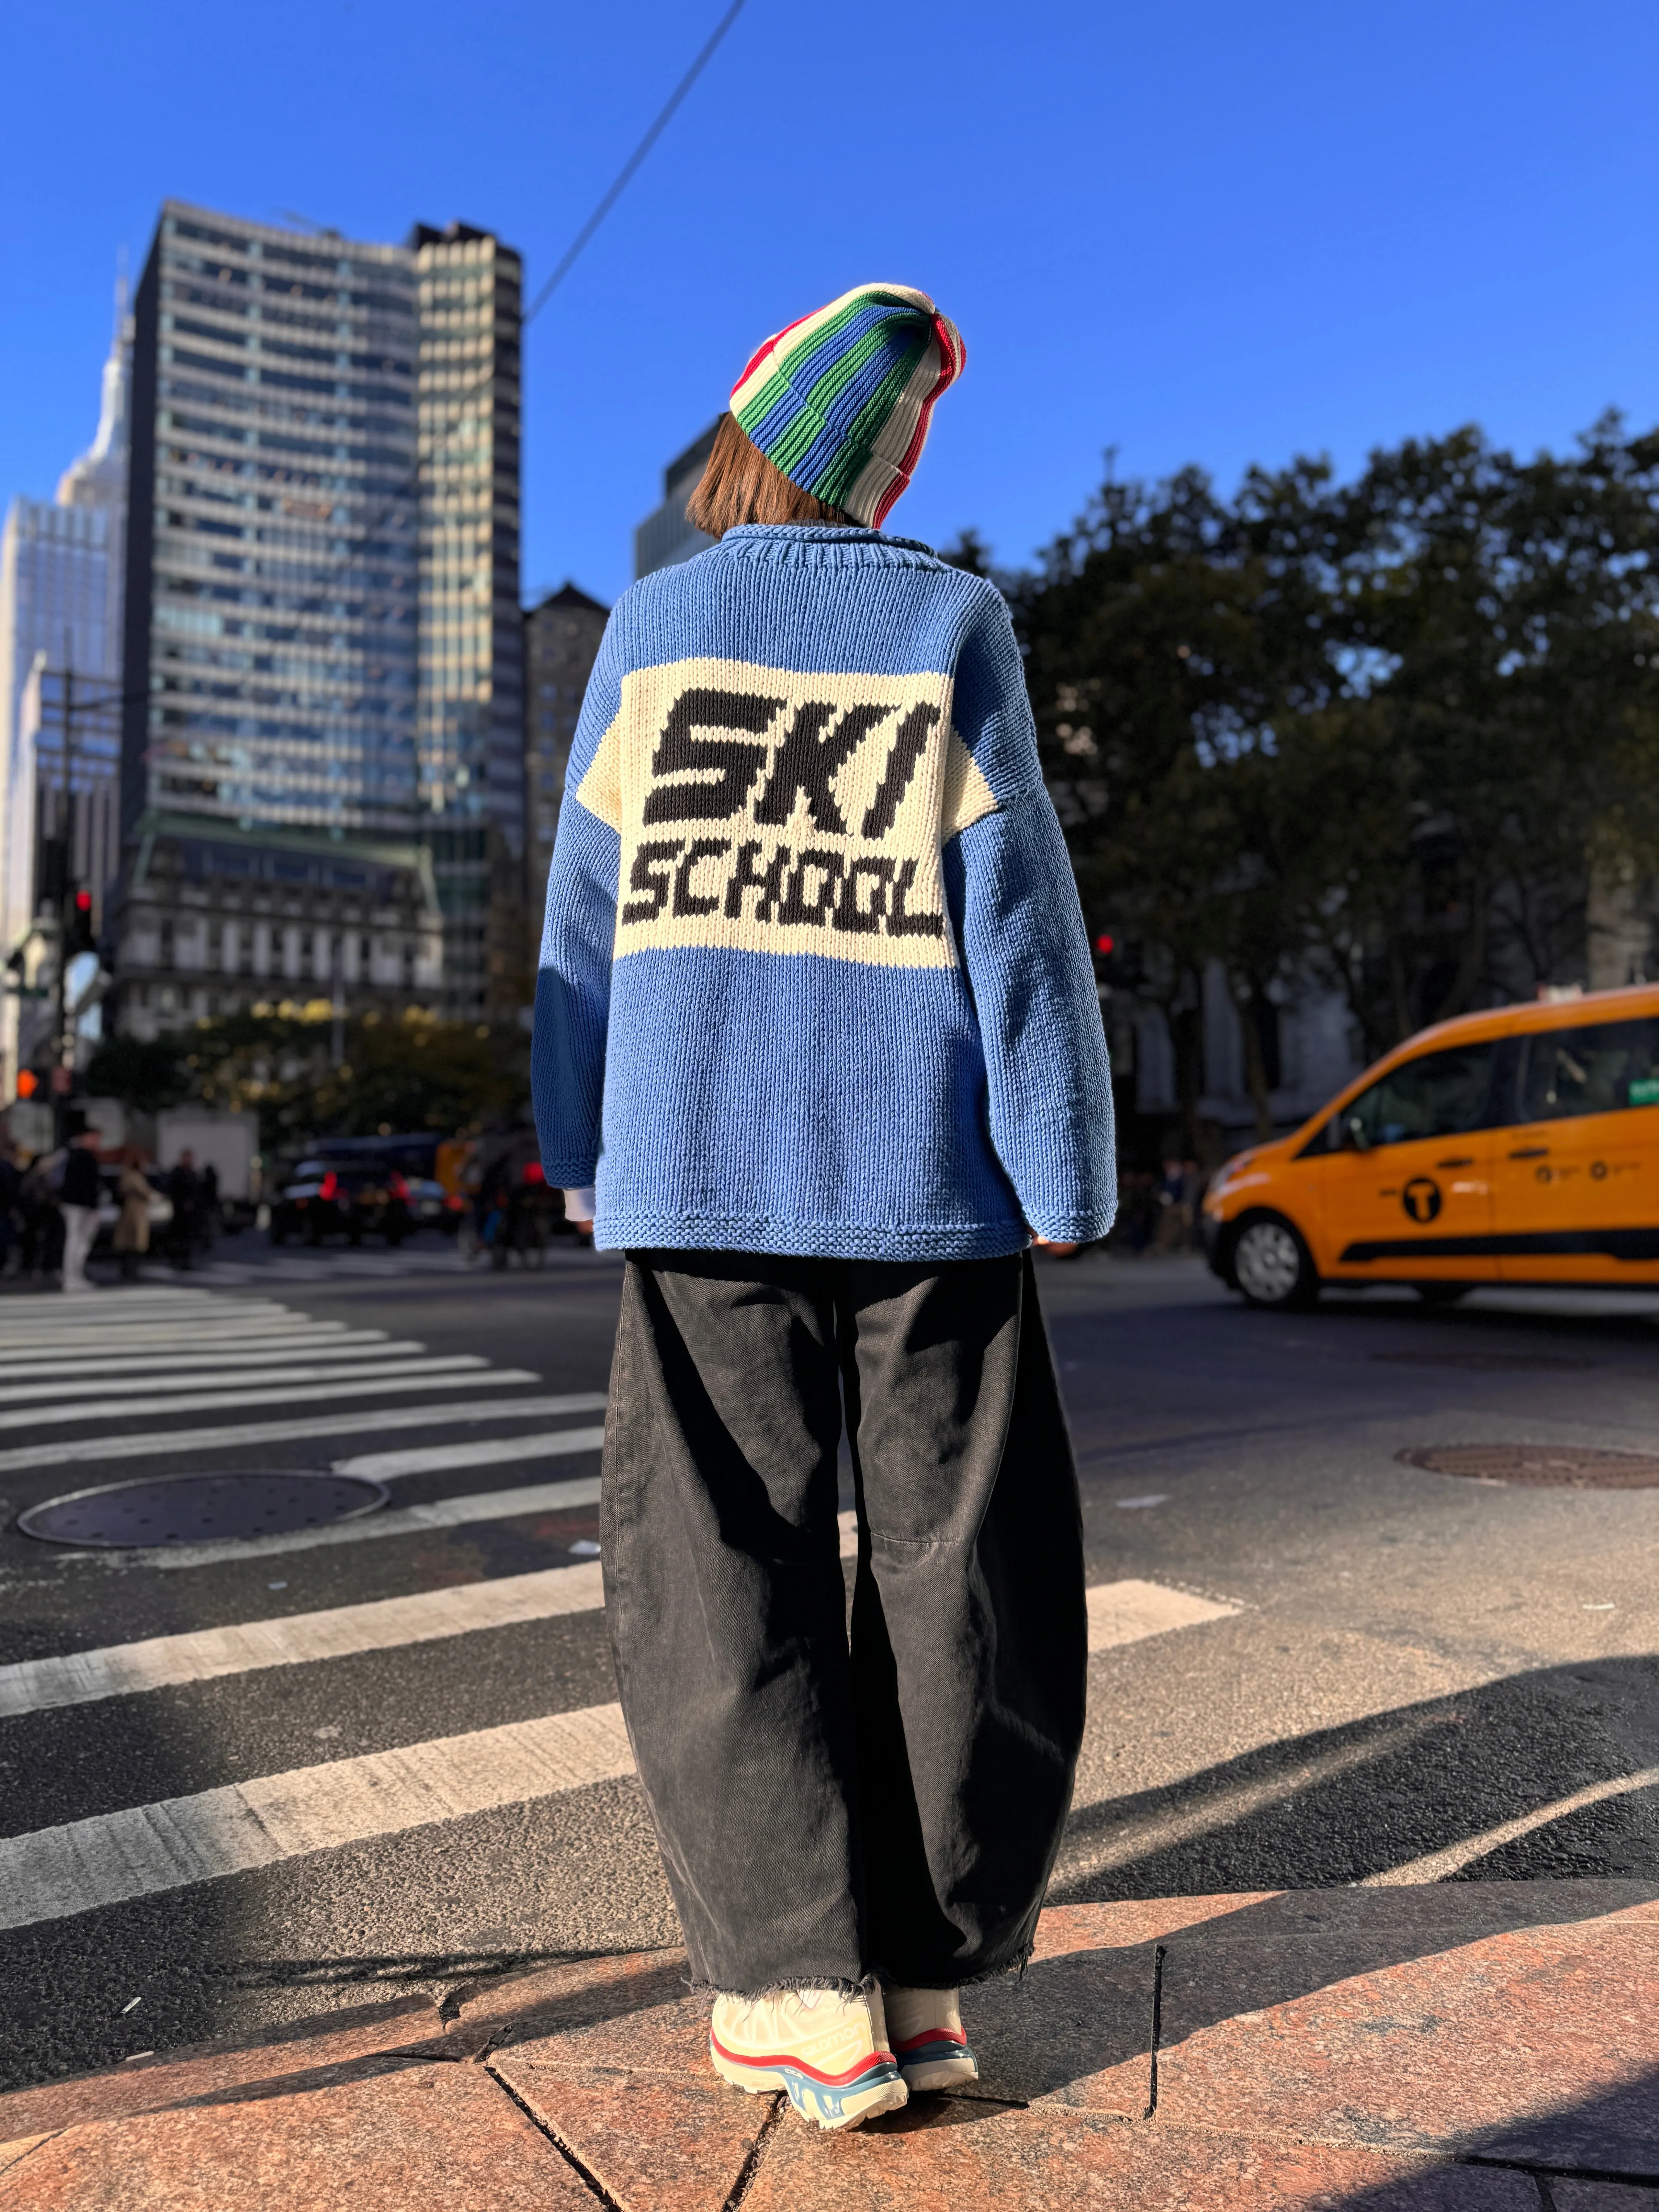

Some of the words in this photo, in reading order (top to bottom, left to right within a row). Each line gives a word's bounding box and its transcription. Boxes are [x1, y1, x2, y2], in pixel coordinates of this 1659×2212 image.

[644, 688, 941, 839] SKI
[622, 838, 944, 939] SCHOOL
[1407, 1182, 1434, 1221] T
[800, 2022, 867, 2058] salomon
